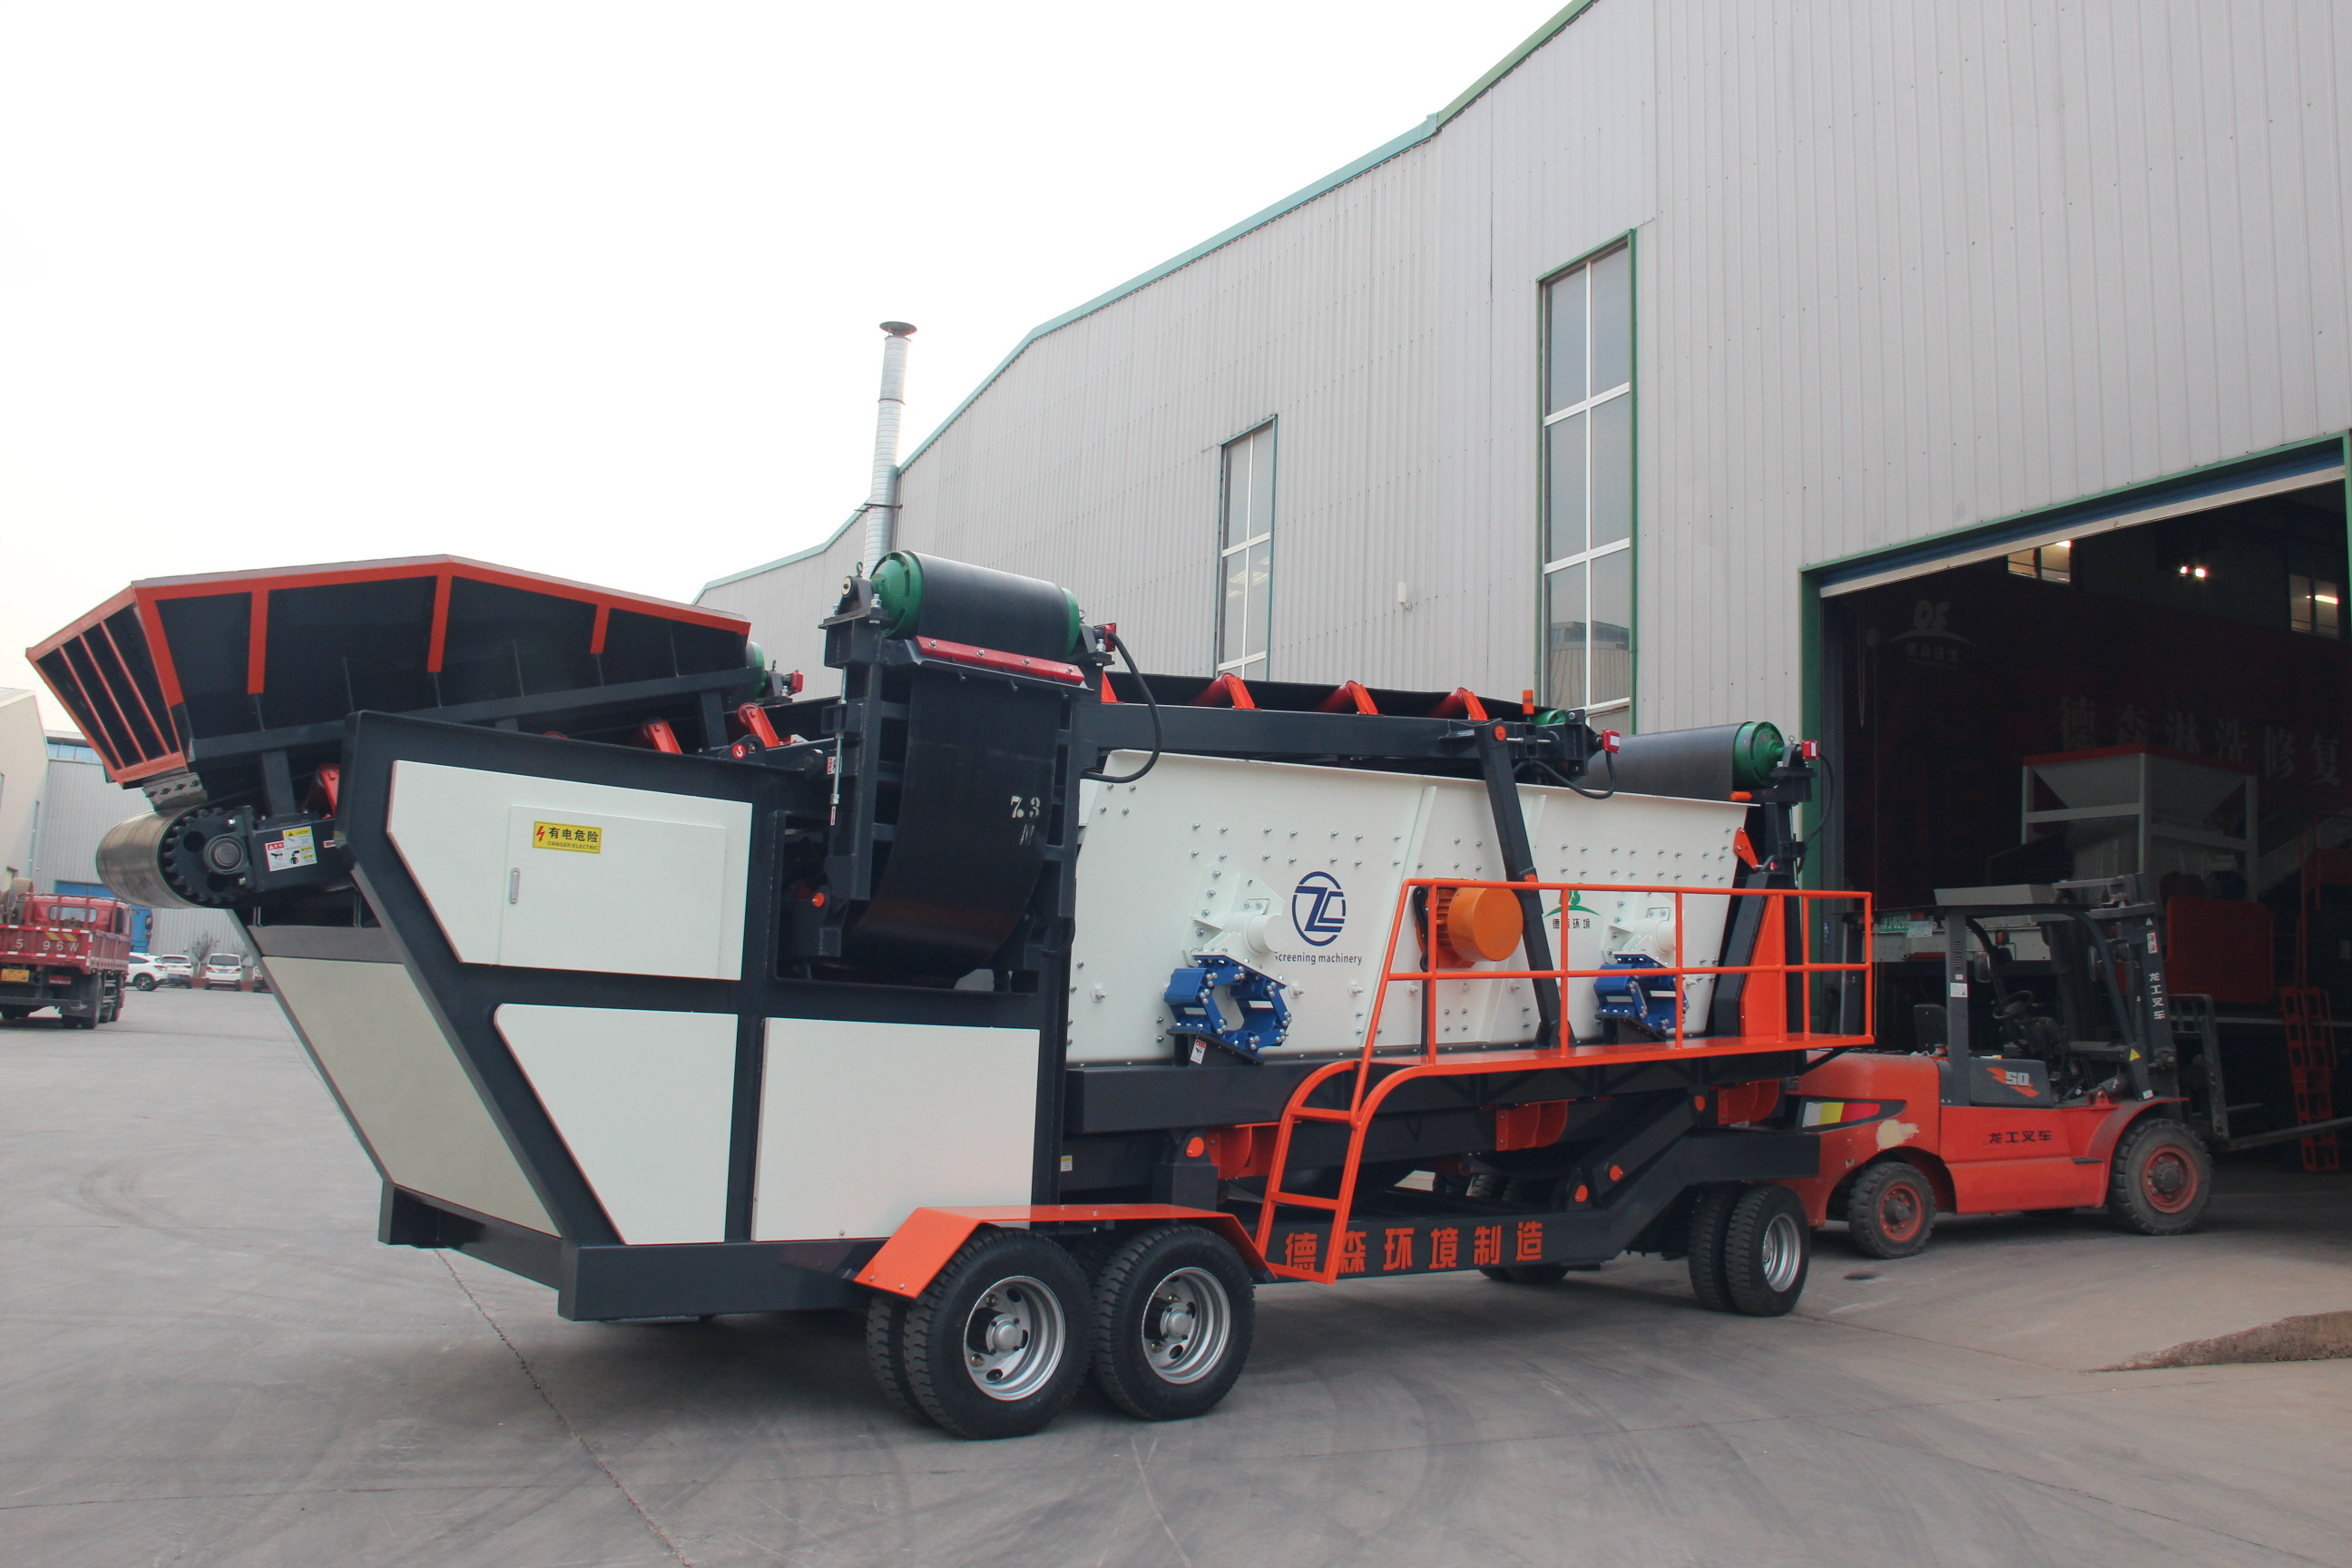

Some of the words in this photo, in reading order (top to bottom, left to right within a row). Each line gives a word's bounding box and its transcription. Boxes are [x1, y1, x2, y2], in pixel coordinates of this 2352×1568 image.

[549, 828, 599, 843] 有电危险
[1553, 918, 1591, 929] 德环境
[1318, 953, 1363, 966] machinery
[2149, 972, 2166, 1020] 龙工叉车
[2005, 1071, 2030, 1086] 50
[1989, 1131, 2053, 1144] 龙工叉车
[1285, 1220, 1544, 1273] 德森环境制造
